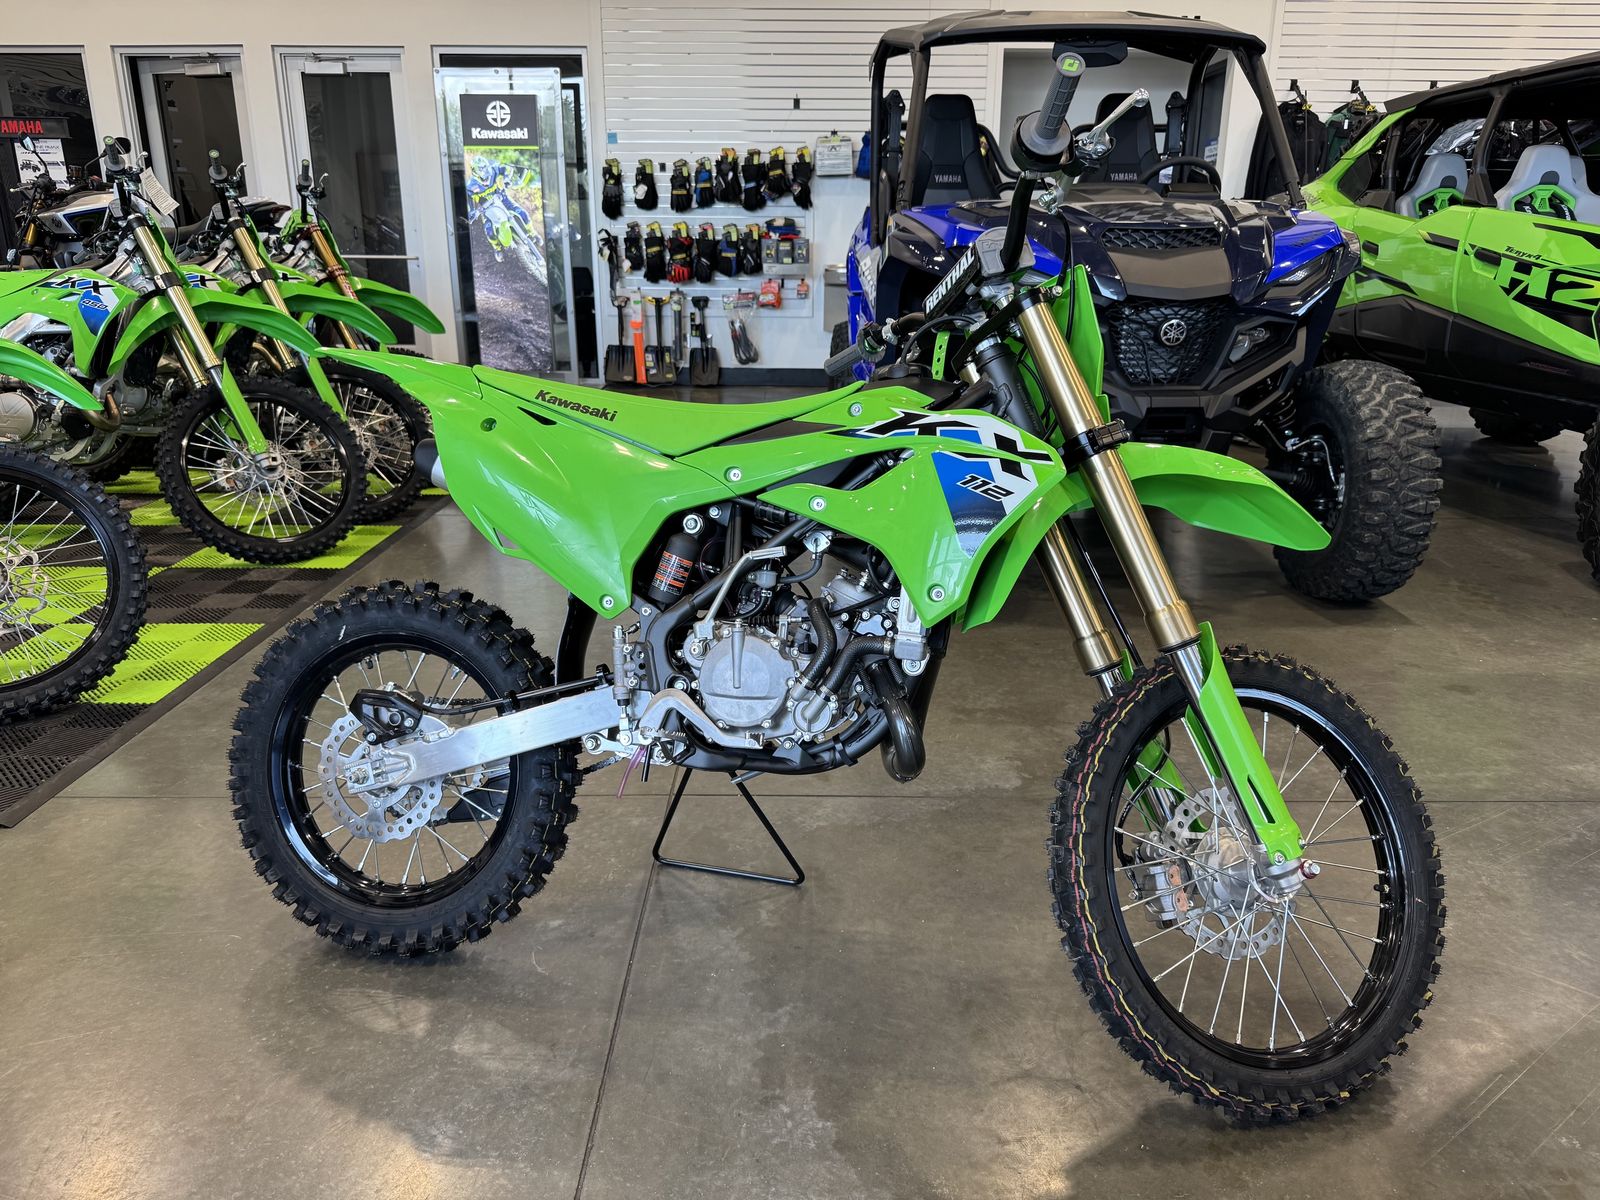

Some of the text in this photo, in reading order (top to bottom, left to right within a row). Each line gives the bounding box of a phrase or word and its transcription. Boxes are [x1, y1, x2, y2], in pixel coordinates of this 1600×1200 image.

[0, 120, 44, 134] AMAHA
[471, 127, 529, 140] Kawasaki
[934, 174, 962, 183] YAMAHA
[1110, 173, 1138, 181] YAMAHA
[54, 276, 117, 296] KX
[925, 246, 976, 315] RENTHAL
[81, 299, 109, 311] 450
[535, 389, 618, 422] Kawasaki
[862, 410, 1054, 482] KX
[957, 473, 1015, 501] 112
